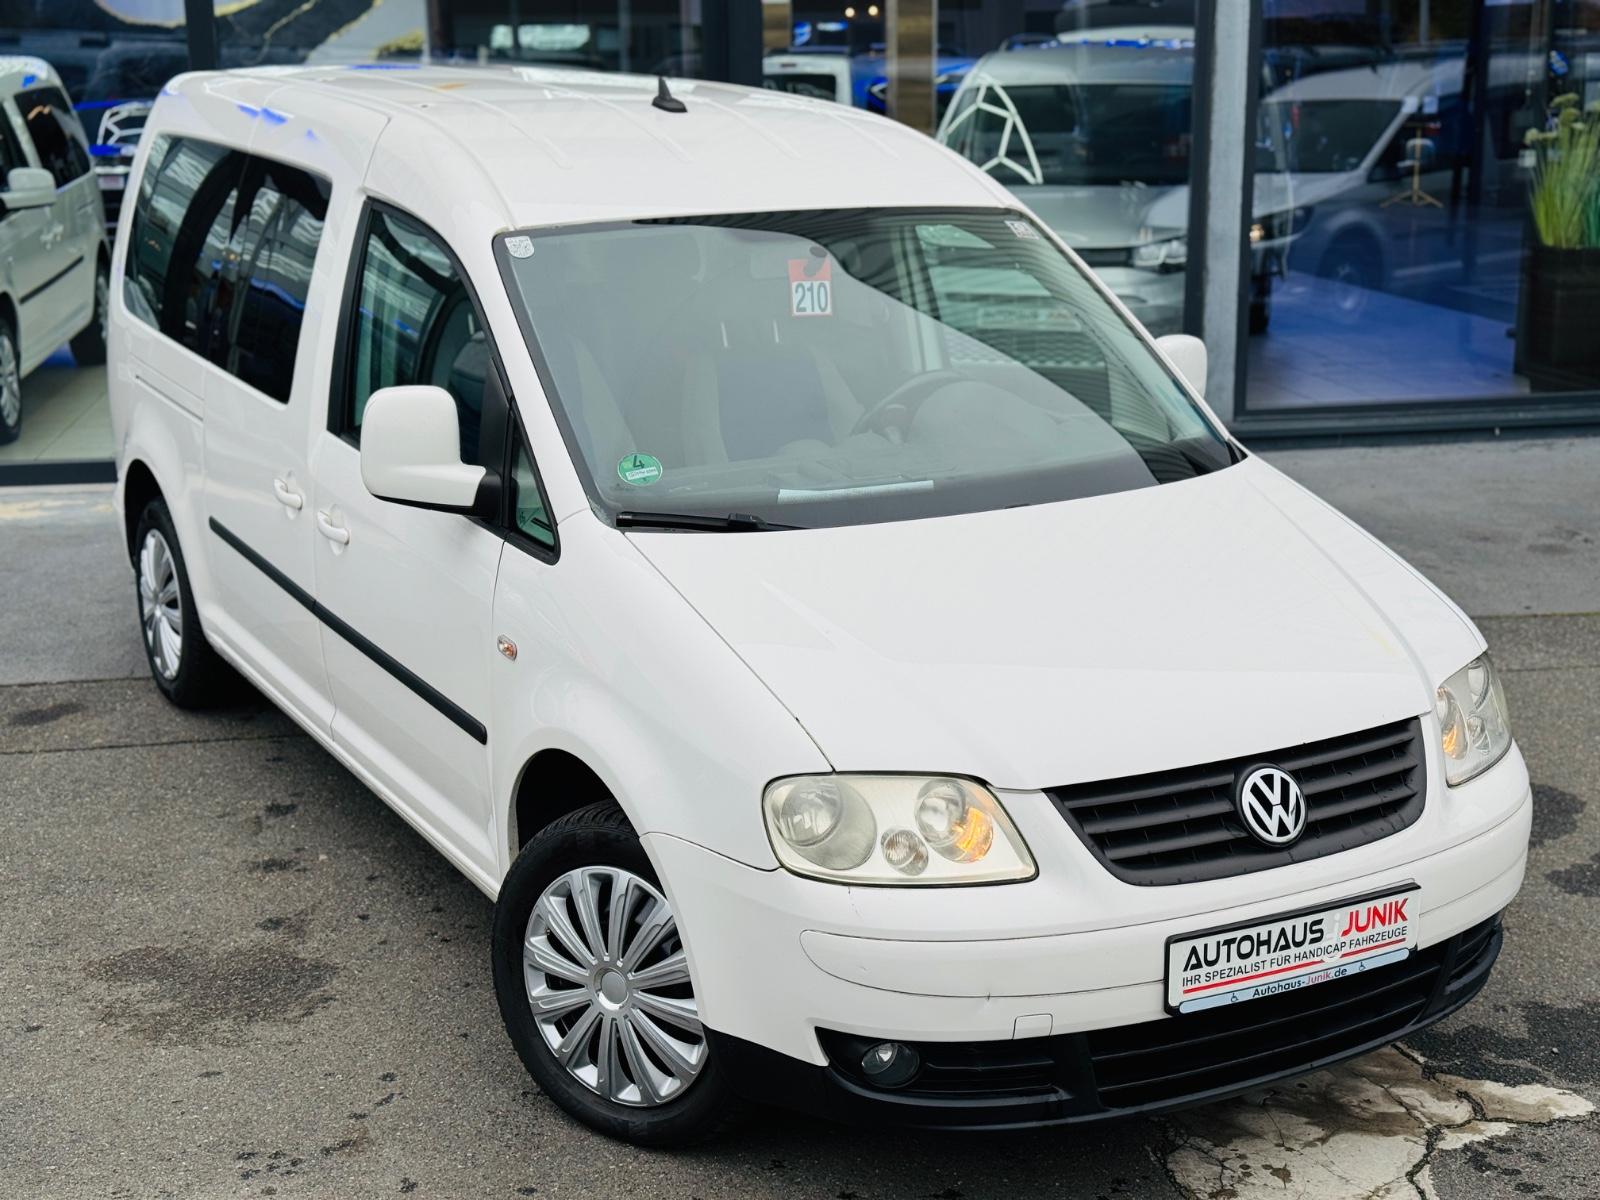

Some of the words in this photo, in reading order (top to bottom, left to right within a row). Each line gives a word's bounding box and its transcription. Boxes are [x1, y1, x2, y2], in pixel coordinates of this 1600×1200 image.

[795, 282, 828, 313] 210
[633, 455, 645, 469] 4
[1242, 768, 1306, 843] VW
[1182, 918, 1325, 972] AUTOHAUS
[1341, 897, 1409, 937] JUNIK
[1182, 974, 1202, 987] IHR
[1204, 960, 1267, 983] SPEZIALIST
[1270, 954, 1291, 969] FÜR
[1293, 941, 1347, 963] HANDICAP
[1349, 925, 1408, 949] FAHRZEUGE
[1252, 967, 1348, 998] Autohaus-Junik.de
